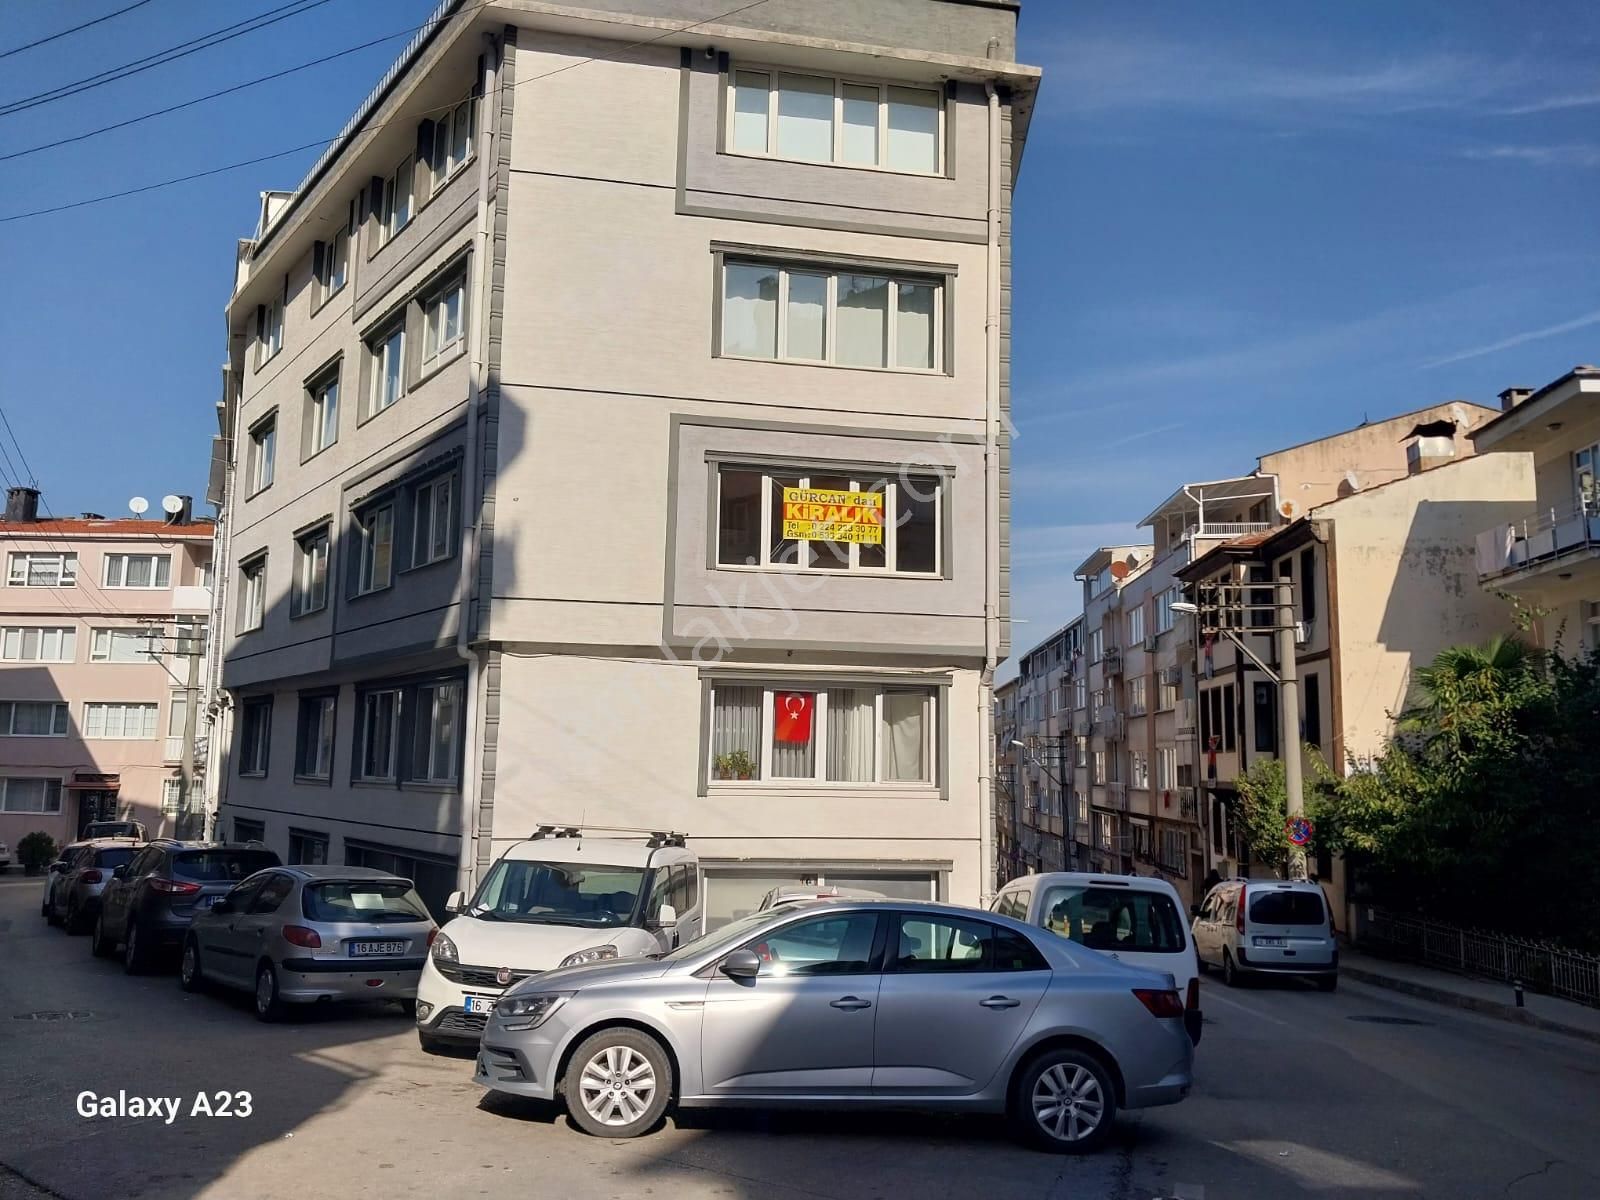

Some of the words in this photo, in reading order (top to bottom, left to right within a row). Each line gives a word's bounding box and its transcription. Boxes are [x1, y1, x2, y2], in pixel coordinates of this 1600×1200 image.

[356, 943, 367, 953] 16
[369, 943, 385, 953] AJE
[472, 1000, 481, 1011] 16
